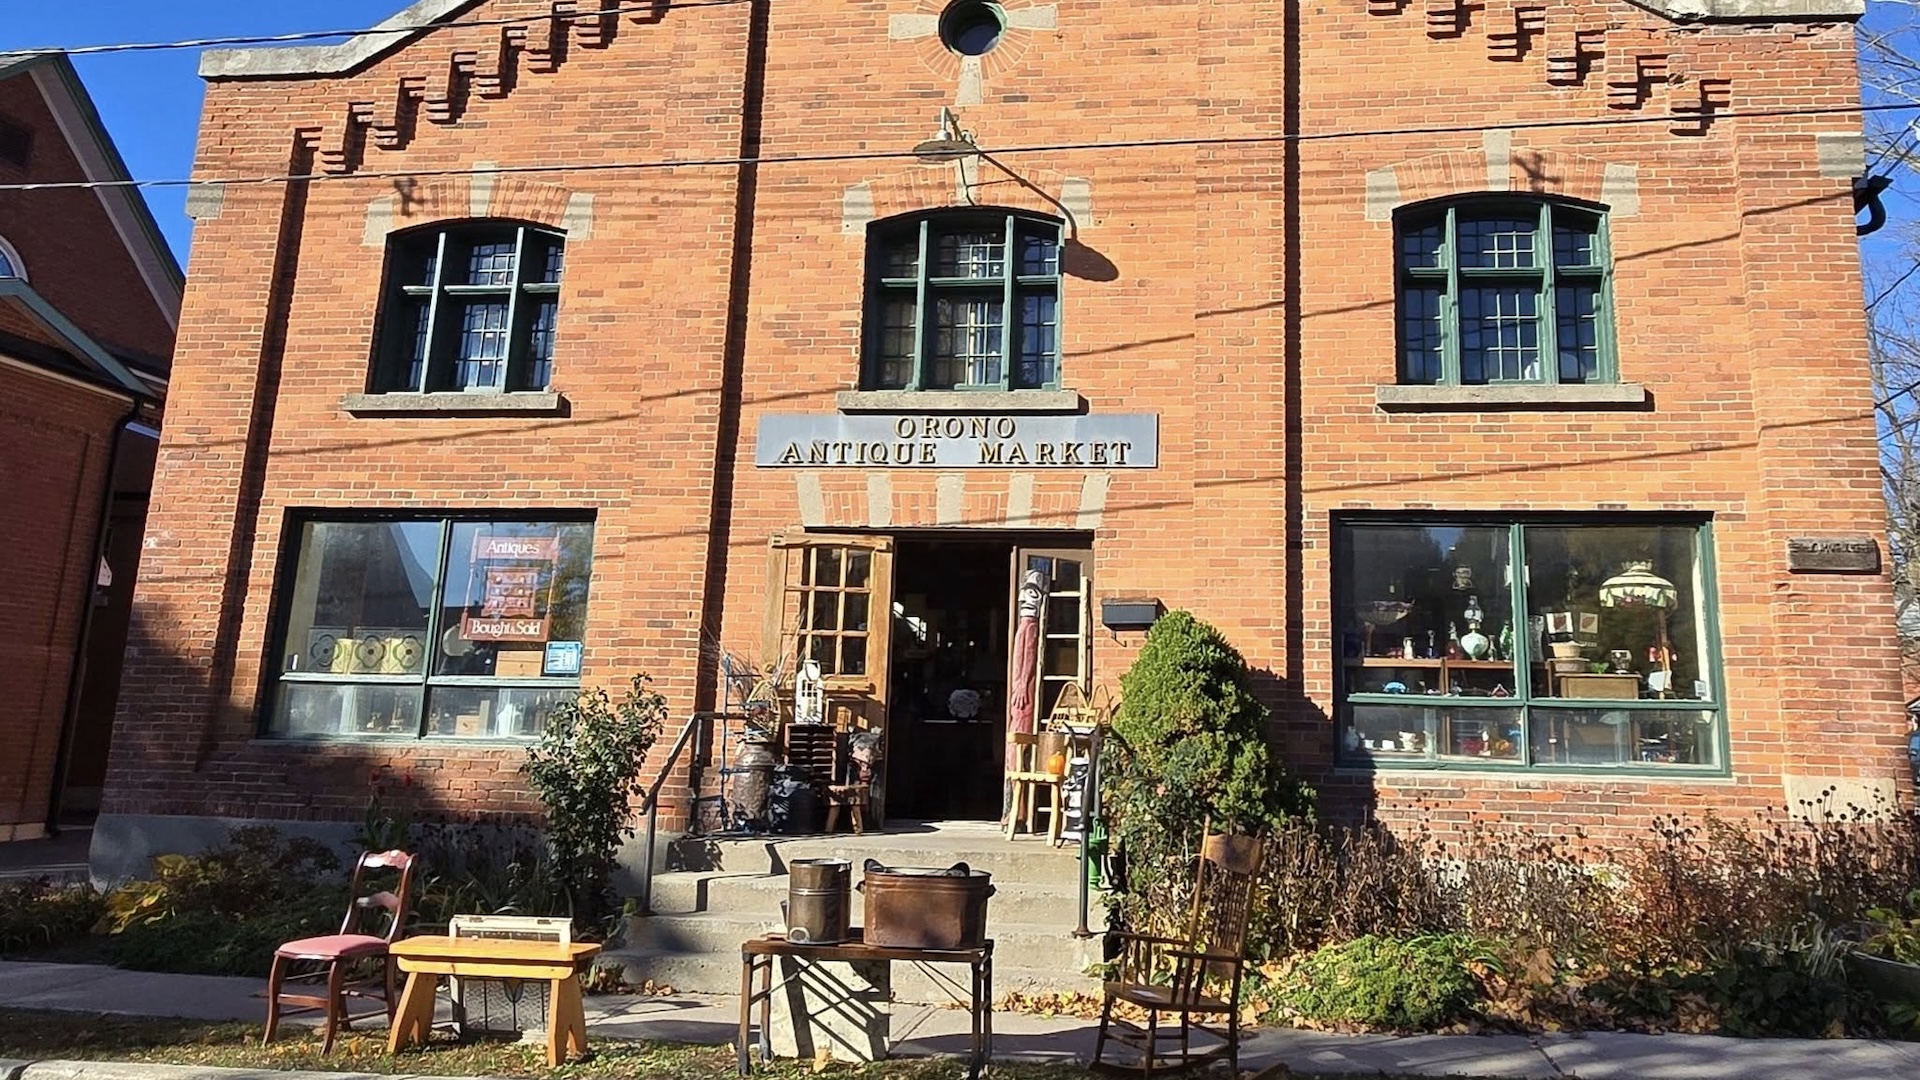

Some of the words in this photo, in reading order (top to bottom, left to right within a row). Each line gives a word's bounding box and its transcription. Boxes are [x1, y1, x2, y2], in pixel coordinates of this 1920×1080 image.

[895, 417, 1016, 439] ORONO
[779, 441, 937, 464] ANTIQUE
[977, 441, 1132, 464] MARKET
[486, 540, 540, 557] Antiques
[471, 619, 510, 638] Bought
[516, 619, 541, 635] Sold
